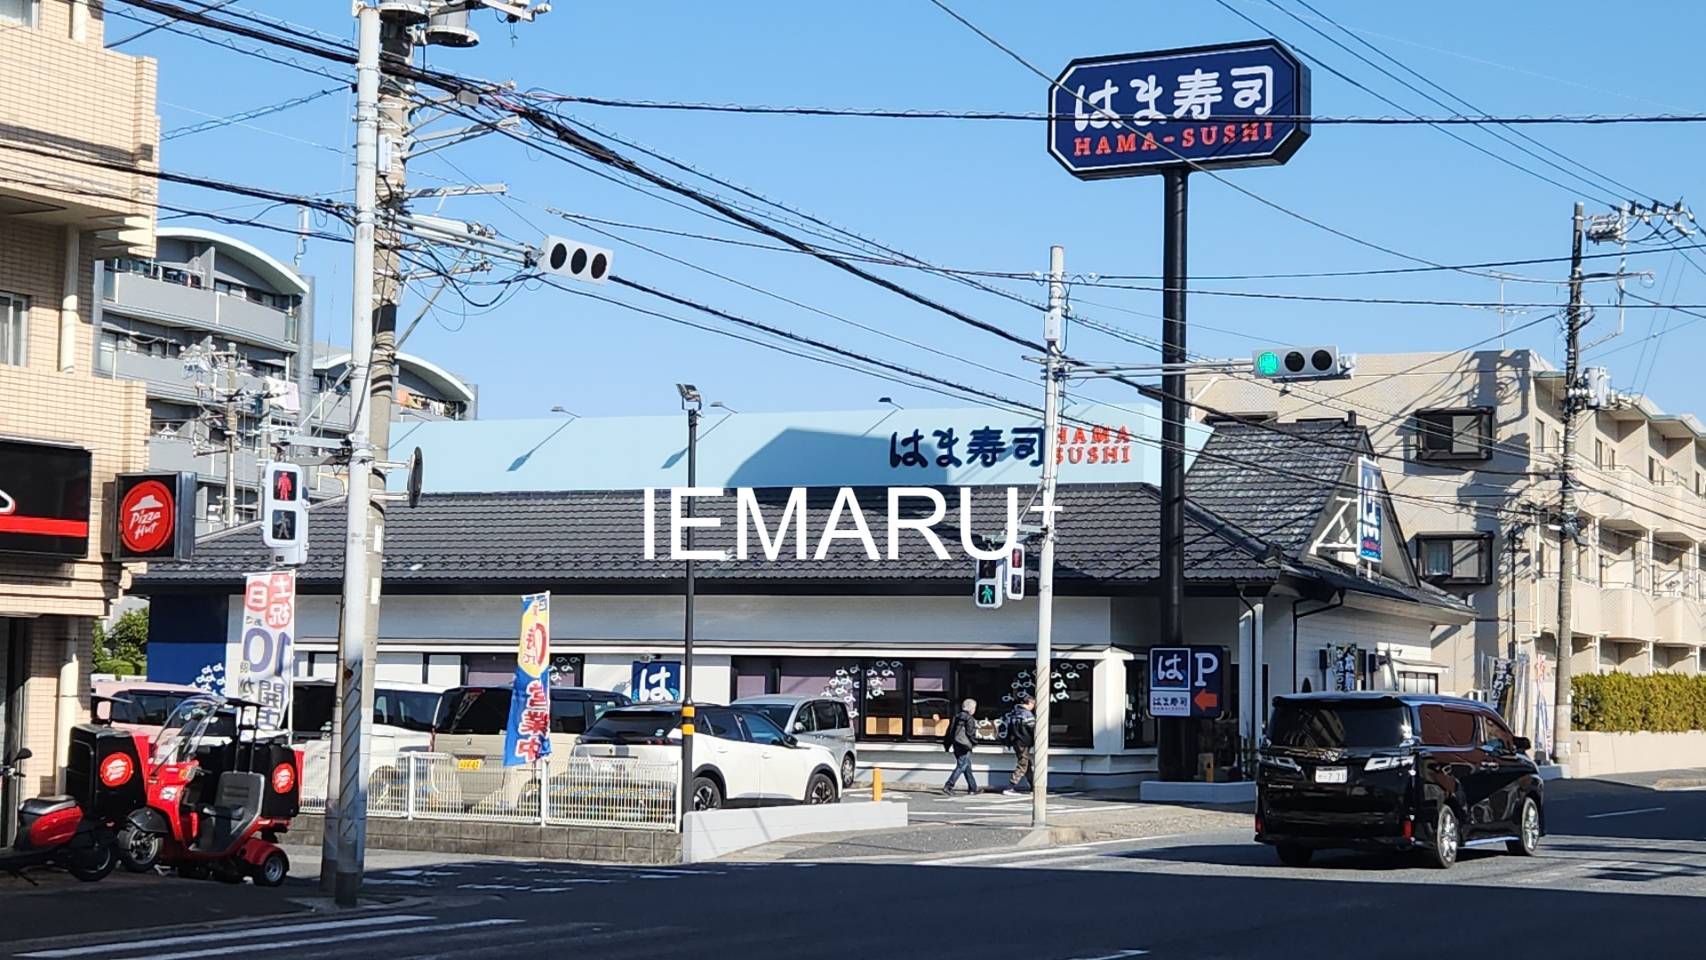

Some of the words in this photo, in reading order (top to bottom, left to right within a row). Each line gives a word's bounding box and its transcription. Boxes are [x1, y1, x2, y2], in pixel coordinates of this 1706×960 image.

[1074, 65, 1274, 132] はま寿司
[1074, 121, 1273, 156] HAMA-SUSHI
[889, 425, 1045, 468] はま寿司
[129, 510, 161, 530] Pizza
[134, 522, 159, 540] Hut
[639, 666, 674, 702] は
[1158, 653, 1184, 681] は
[1194, 652, 1219, 687] P
